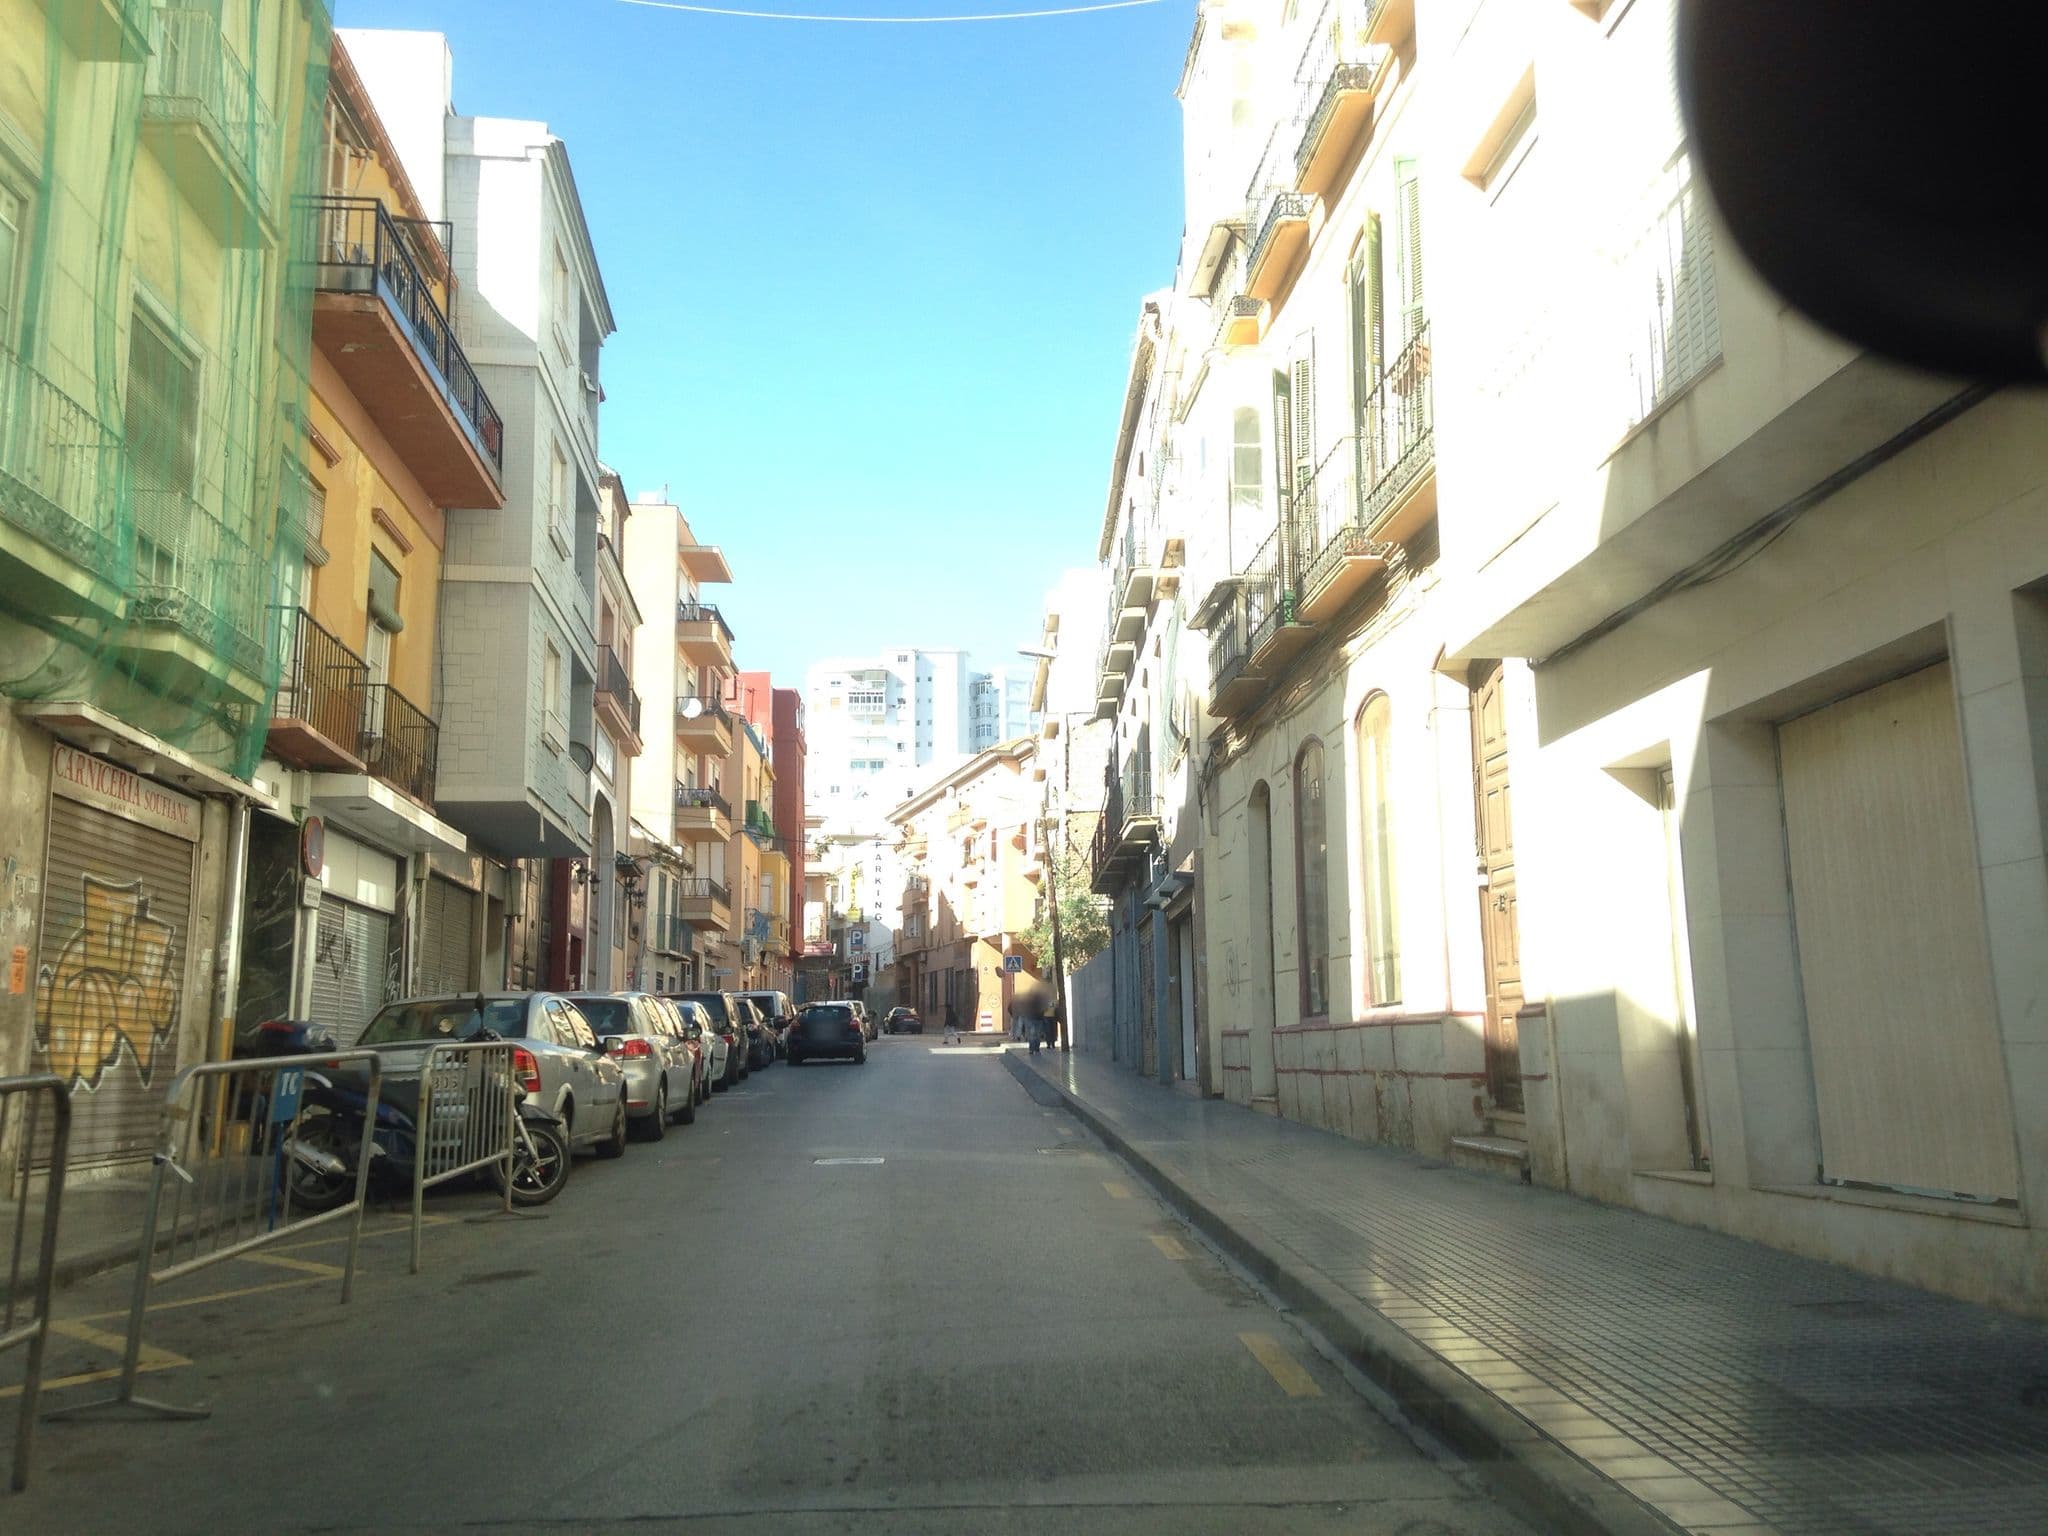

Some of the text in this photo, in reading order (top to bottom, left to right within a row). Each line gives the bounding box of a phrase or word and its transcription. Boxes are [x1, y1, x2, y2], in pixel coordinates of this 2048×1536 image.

[55, 746, 141, 807] CARNICERIA
[874, 841, 883, 922] PARKING
[852, 930, 862, 944] P
[852, 963, 862, 980] P
